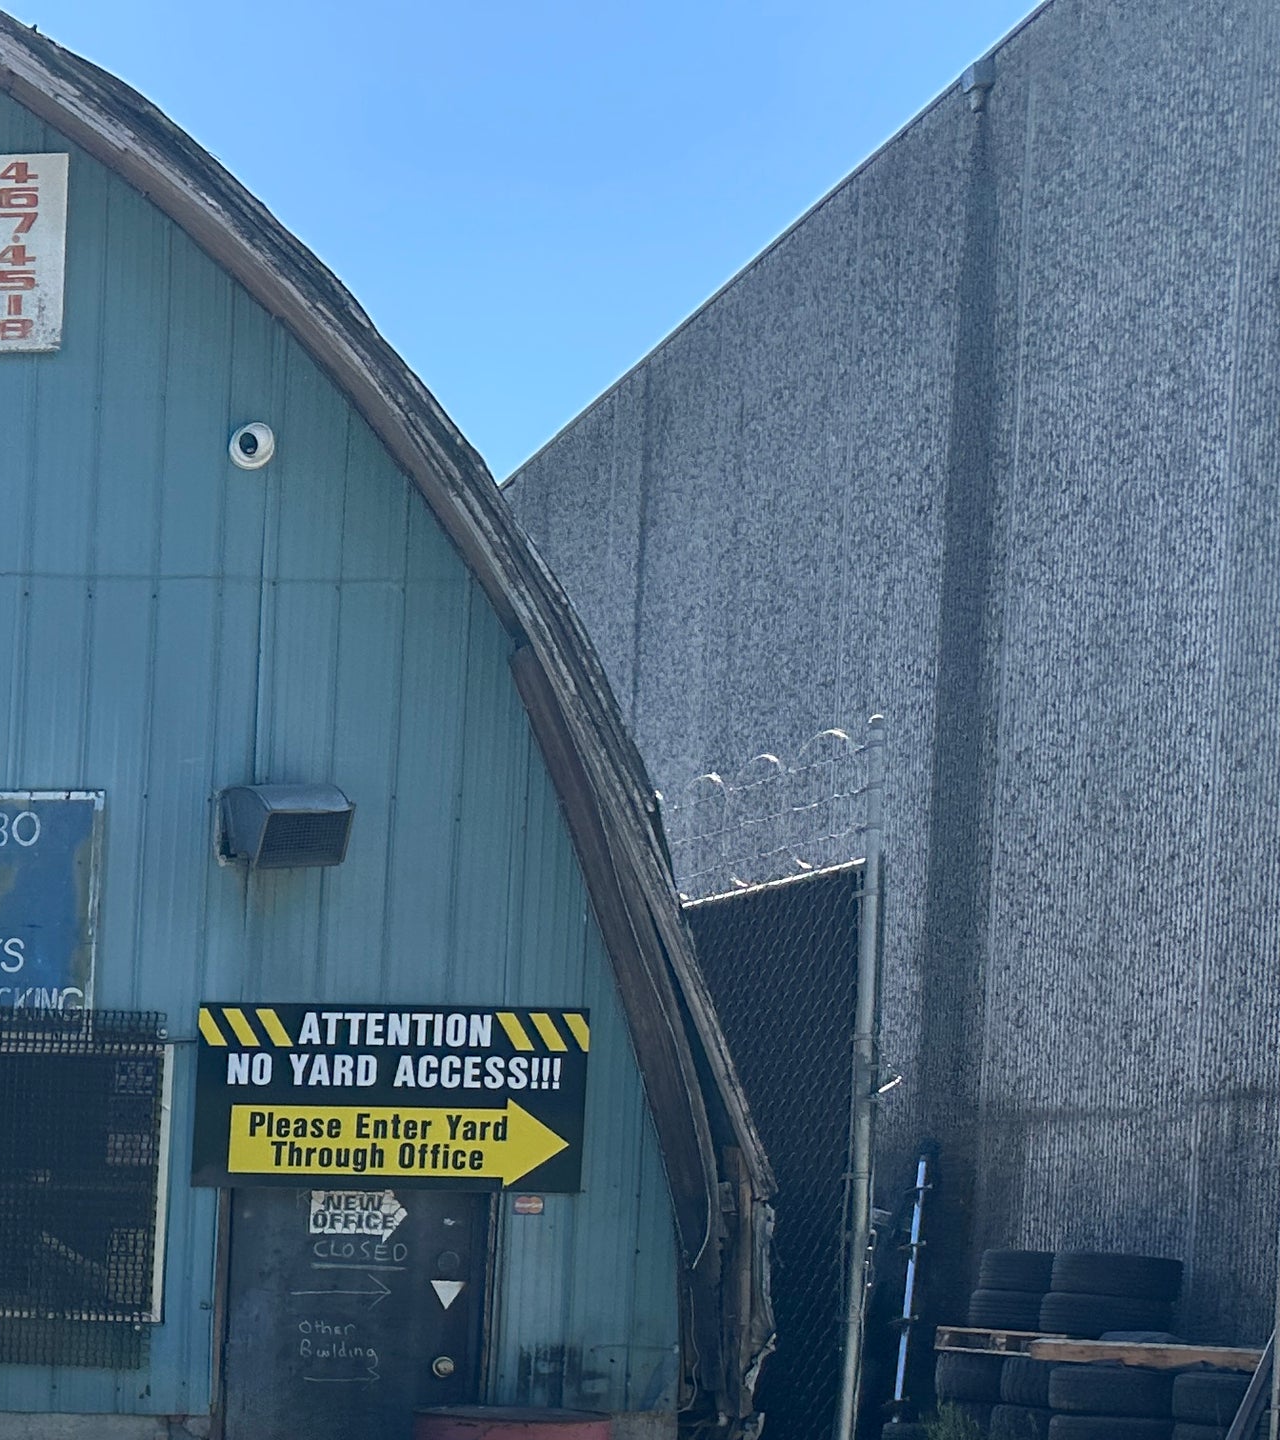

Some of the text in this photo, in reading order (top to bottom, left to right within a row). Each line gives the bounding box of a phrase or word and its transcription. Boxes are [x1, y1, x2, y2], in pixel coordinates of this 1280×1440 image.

[297, 1011, 493, 1048] ATTENTION
[226, 1052, 562, 1090] NO YARD ACCESS!!!
[248, 1111, 509, 1142] Please Enter Yard
[271, 1140, 484, 1173] Through Office
[325, 1193, 384, 1211] NEW
[312, 1209, 395, 1230] OFFICE
[313, 1240, 408, 1262] CLOSED
[298, 1319, 356, 1335] Other
